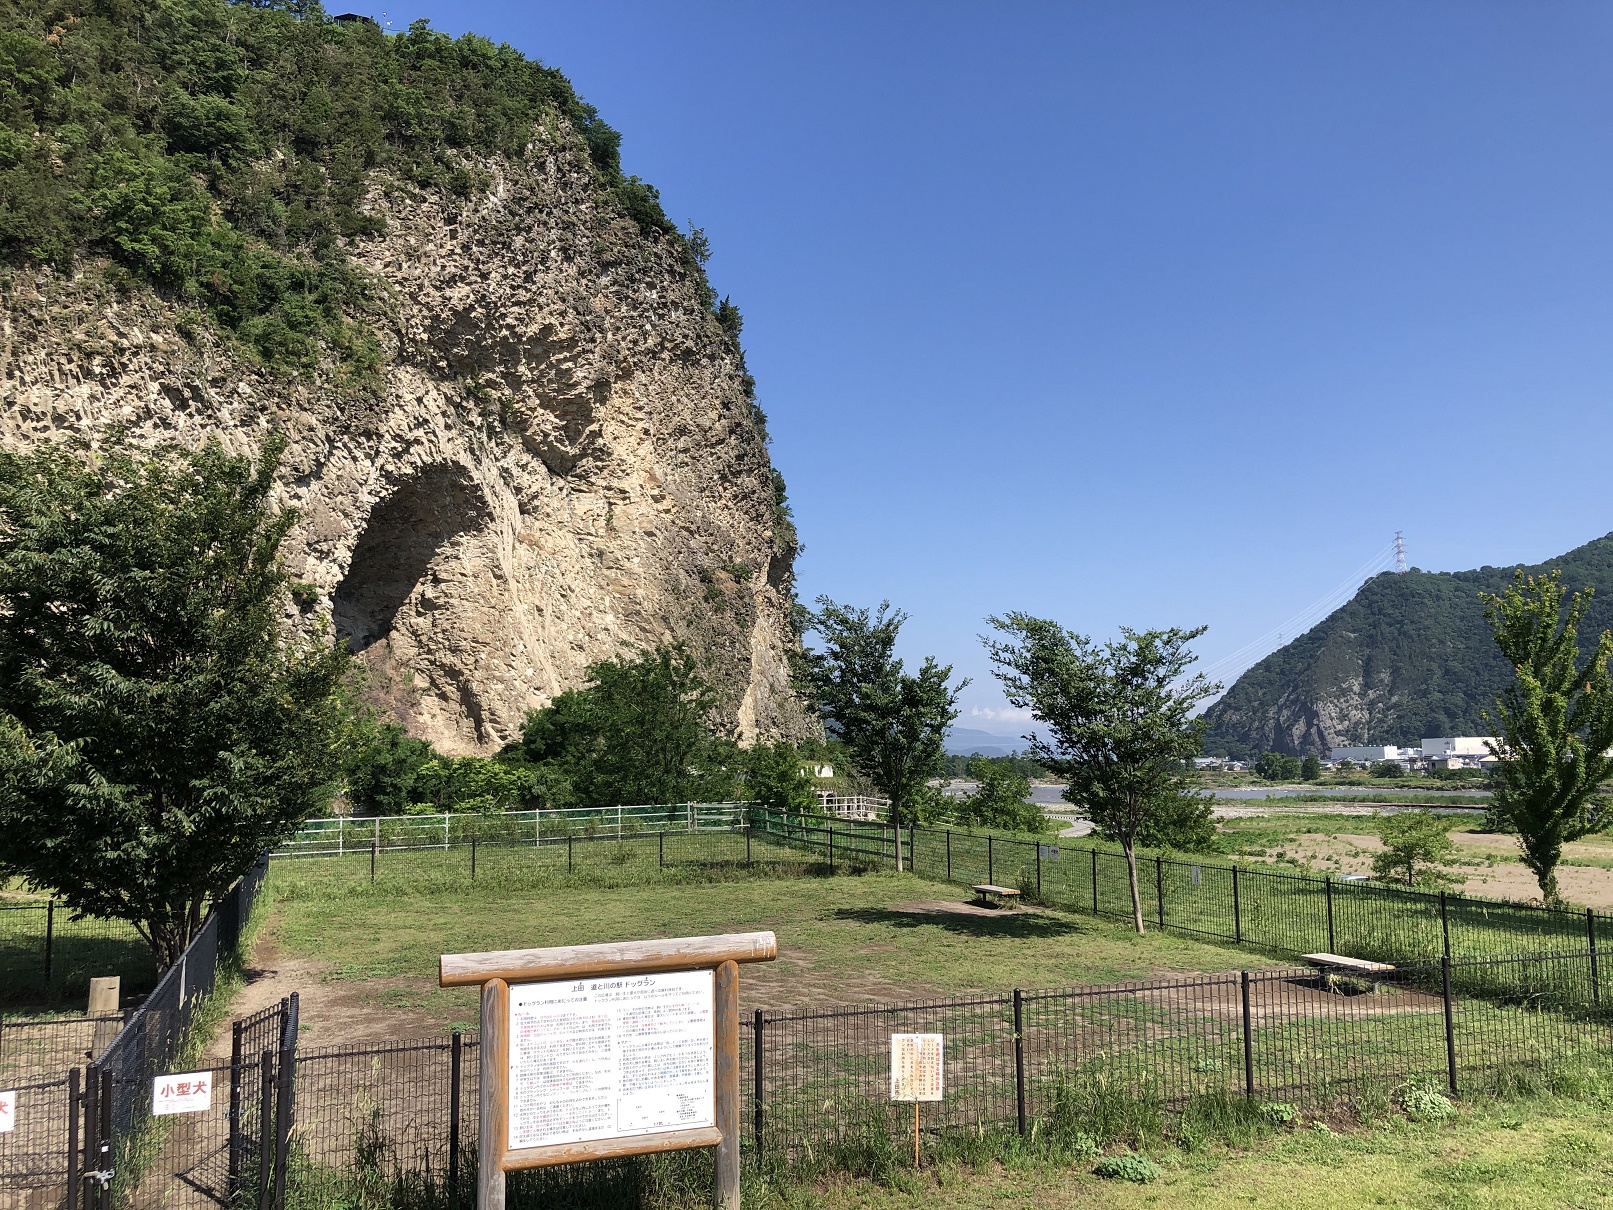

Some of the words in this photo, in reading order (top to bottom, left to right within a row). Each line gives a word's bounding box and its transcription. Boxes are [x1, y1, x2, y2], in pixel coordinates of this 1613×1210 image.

[571, 984, 585, 993] 上田
[625, 979, 656, 988] ドッグラン
[160, 1080, 208, 1098] 小型犬
